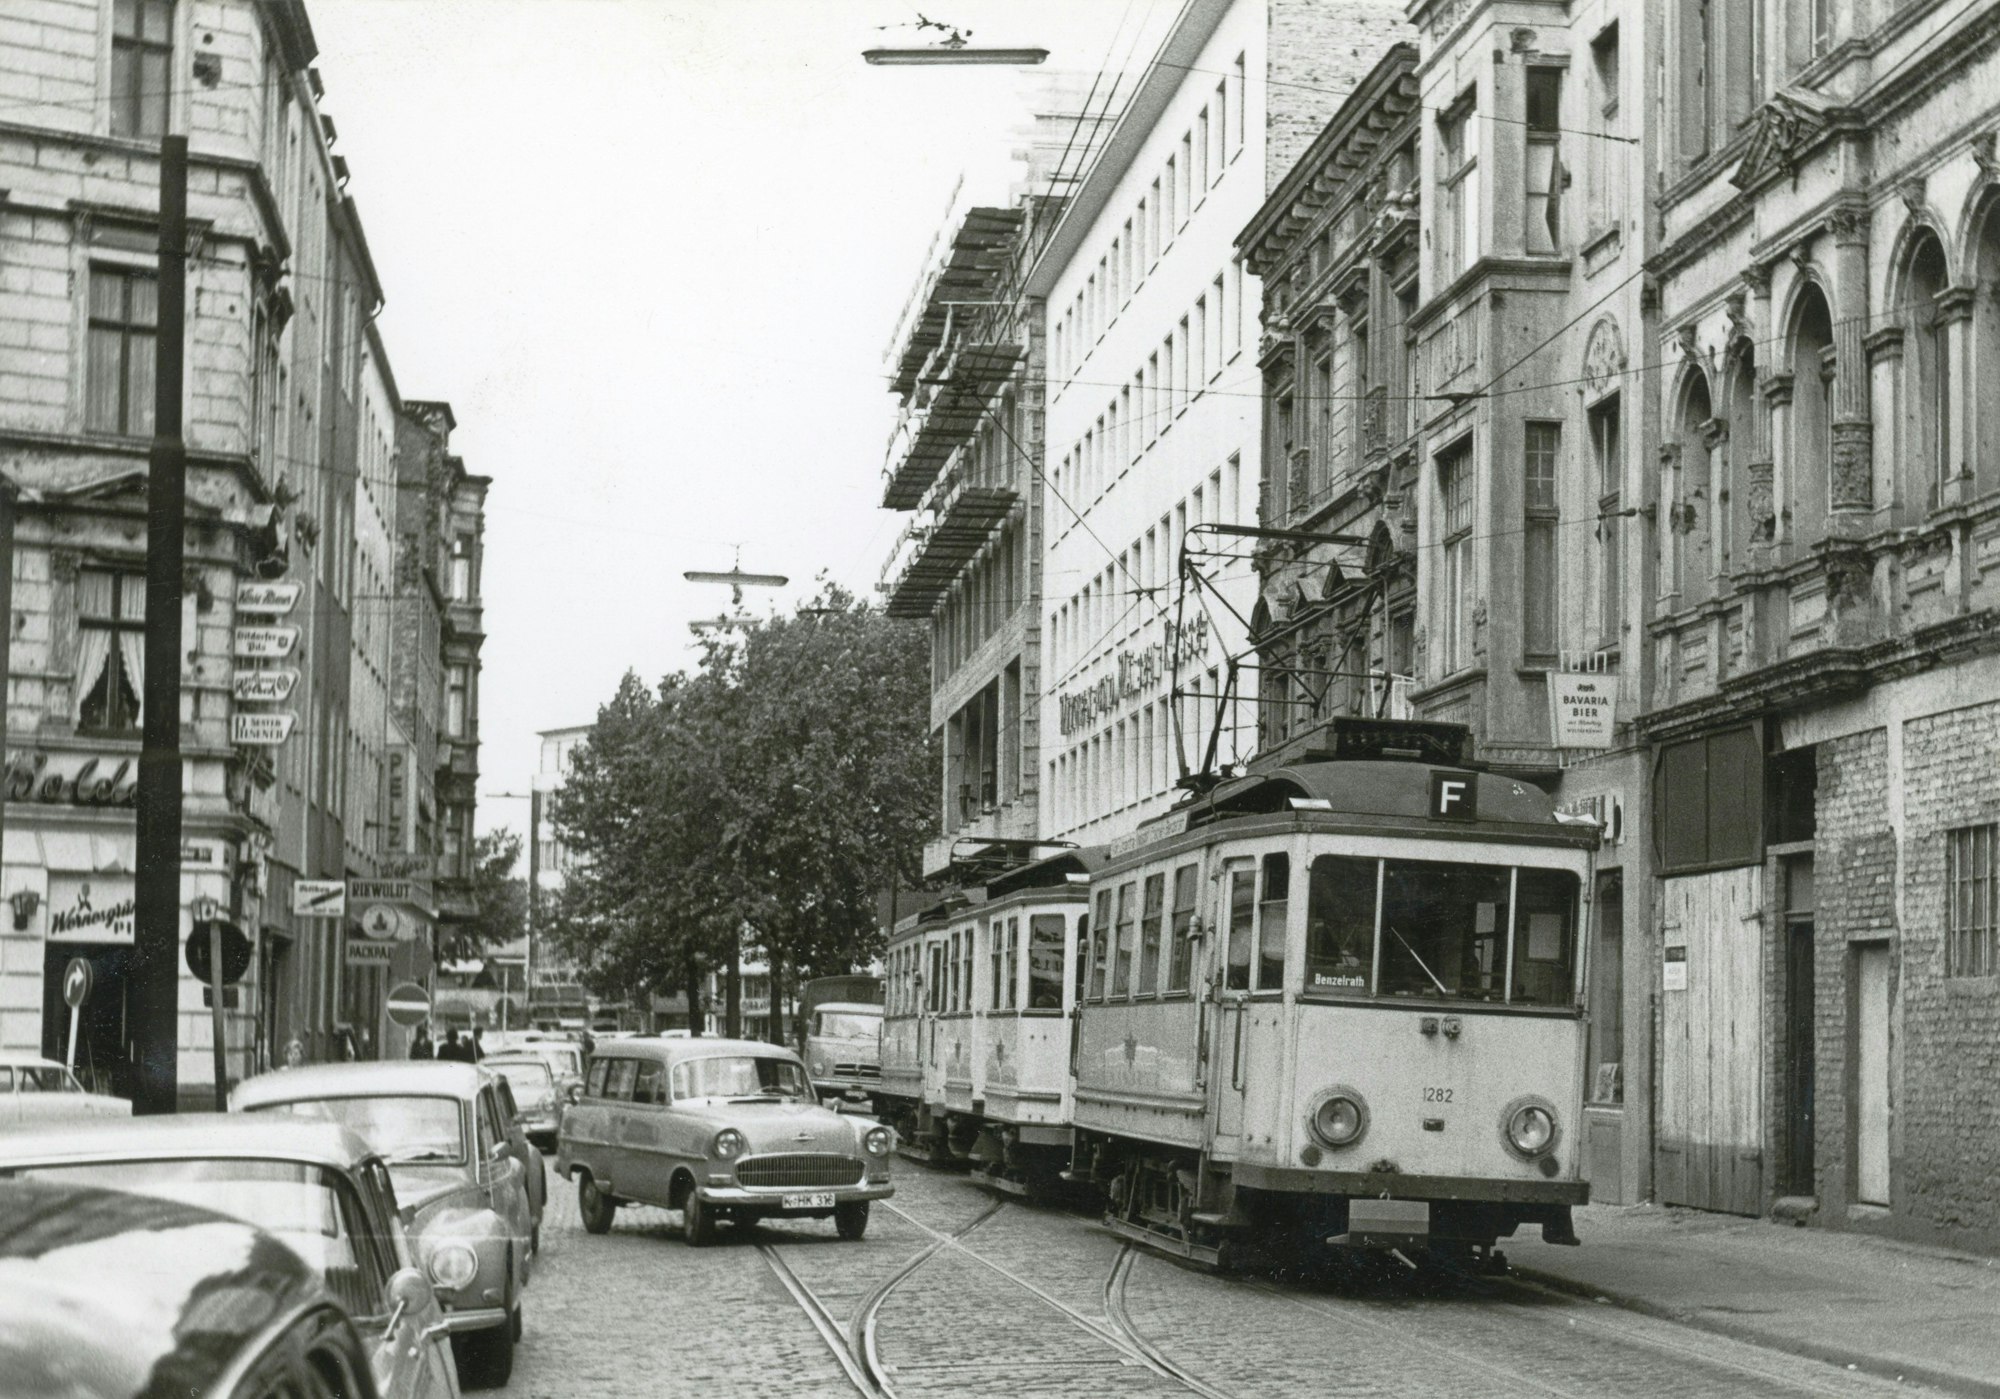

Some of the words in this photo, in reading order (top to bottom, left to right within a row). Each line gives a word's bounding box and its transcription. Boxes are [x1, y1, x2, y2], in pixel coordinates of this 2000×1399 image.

[1563, 695, 1608, 706] BAVARIA
[1573, 708, 1598, 717] BIER
[389, 752, 402, 848] PELZ
[1440, 780, 1466, 814] F
[1314, 973, 1365, 987] Benzelrath
[1422, 1087, 1453, 1103] 1282
